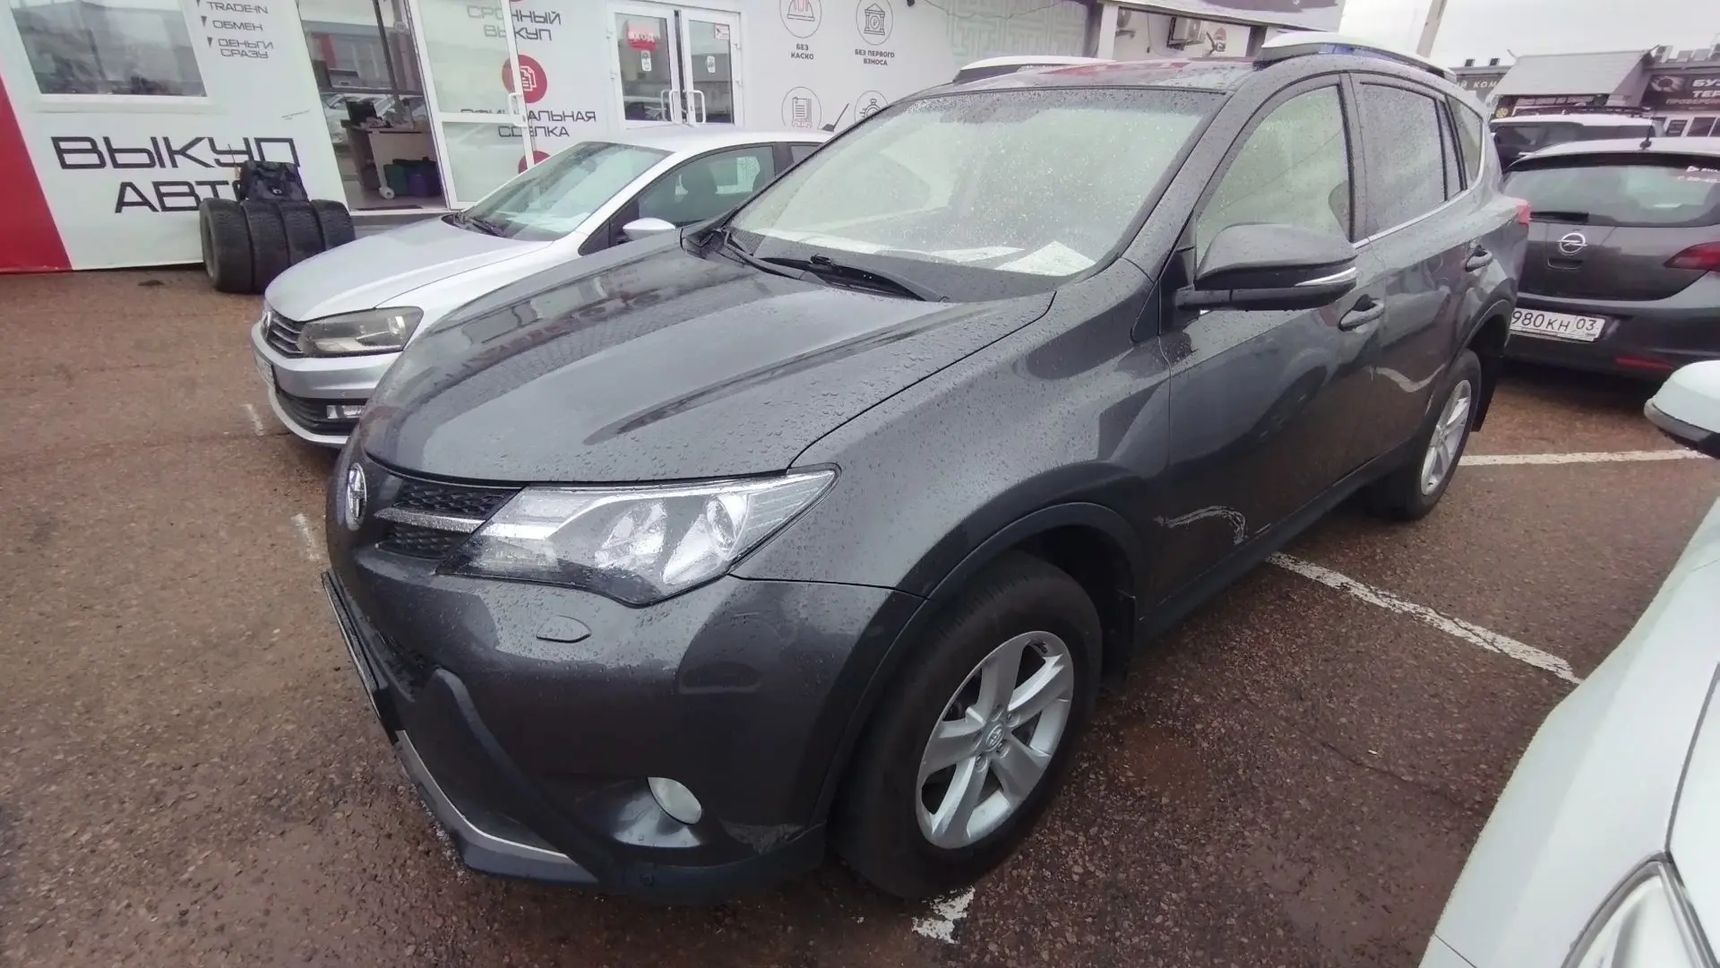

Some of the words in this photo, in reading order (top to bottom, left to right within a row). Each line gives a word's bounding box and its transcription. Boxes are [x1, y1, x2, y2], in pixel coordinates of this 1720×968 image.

[212, 20, 263, 31] ОБМЕН
[218, 38, 274, 49] ДЕНЬГИ
[796, 43, 809, 51] БЕЗ
[220, 48, 269, 59] СРАЗУ
[790, 51, 814, 60] КАСКО
[855, 48, 866, 56] БЕЗ
[867, 49, 895, 58] ПЕРВОГО
[863, 58, 888, 66] ВЗНОСА
[51, 136, 301, 170] ВЫКУП
[115, 180, 244, 213] АВТ
[1576, 318, 1597, 331] 03
